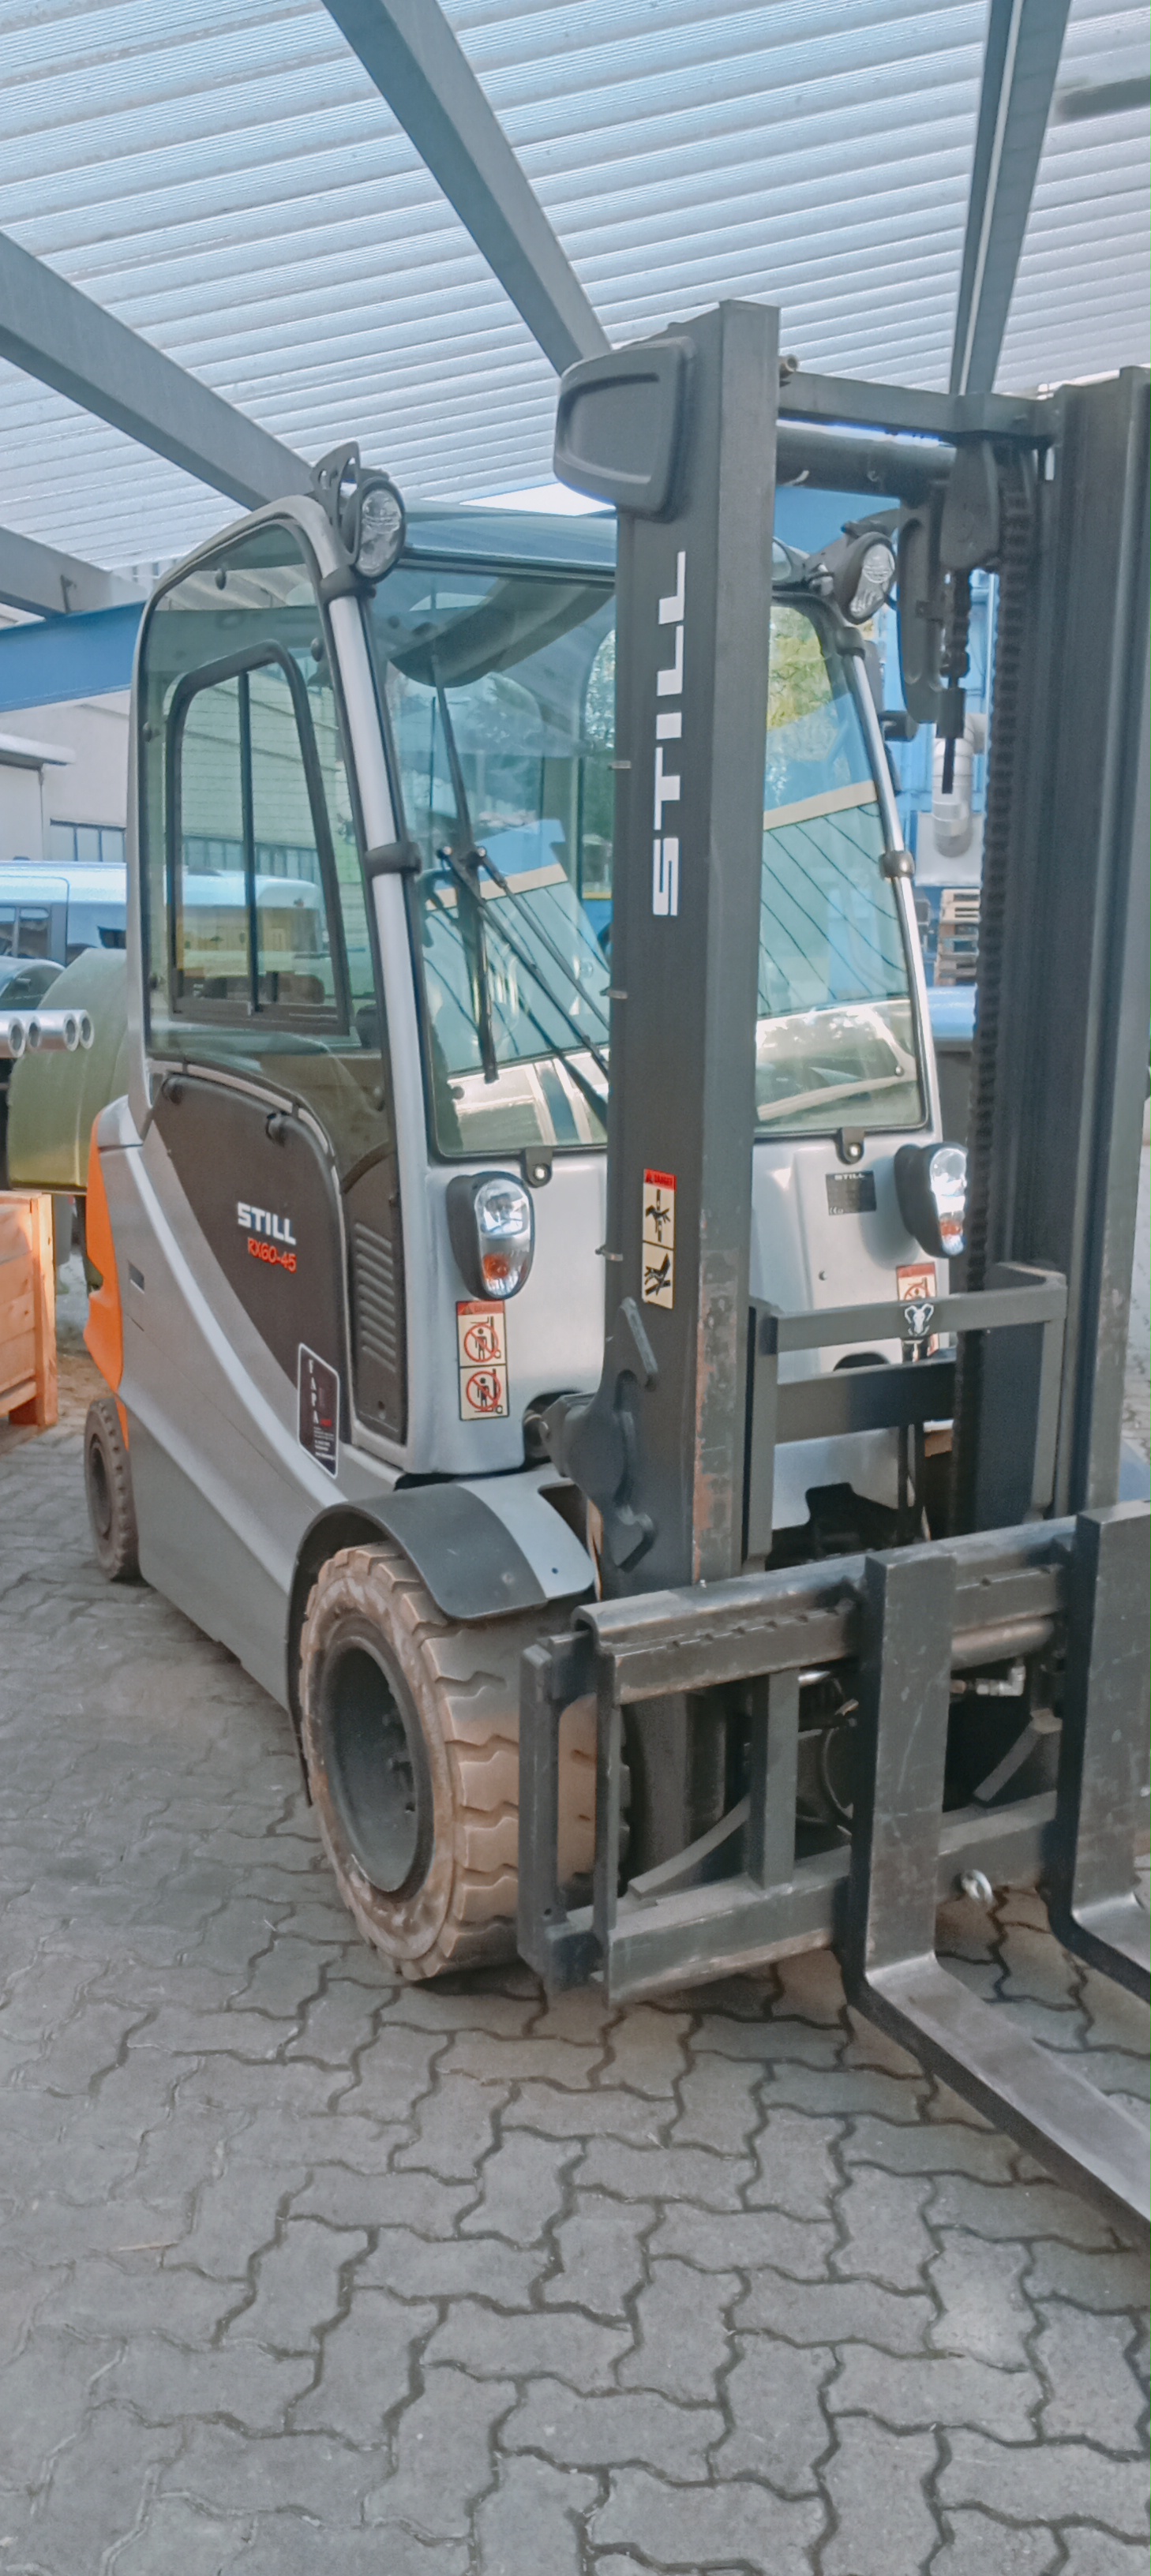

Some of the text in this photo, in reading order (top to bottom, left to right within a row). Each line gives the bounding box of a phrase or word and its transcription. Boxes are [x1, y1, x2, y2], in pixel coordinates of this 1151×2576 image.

[652, 550, 686, 916] STILL
[238, 1200, 297, 1246] STILL
[247, 1237, 297, 1273] RX60-45
